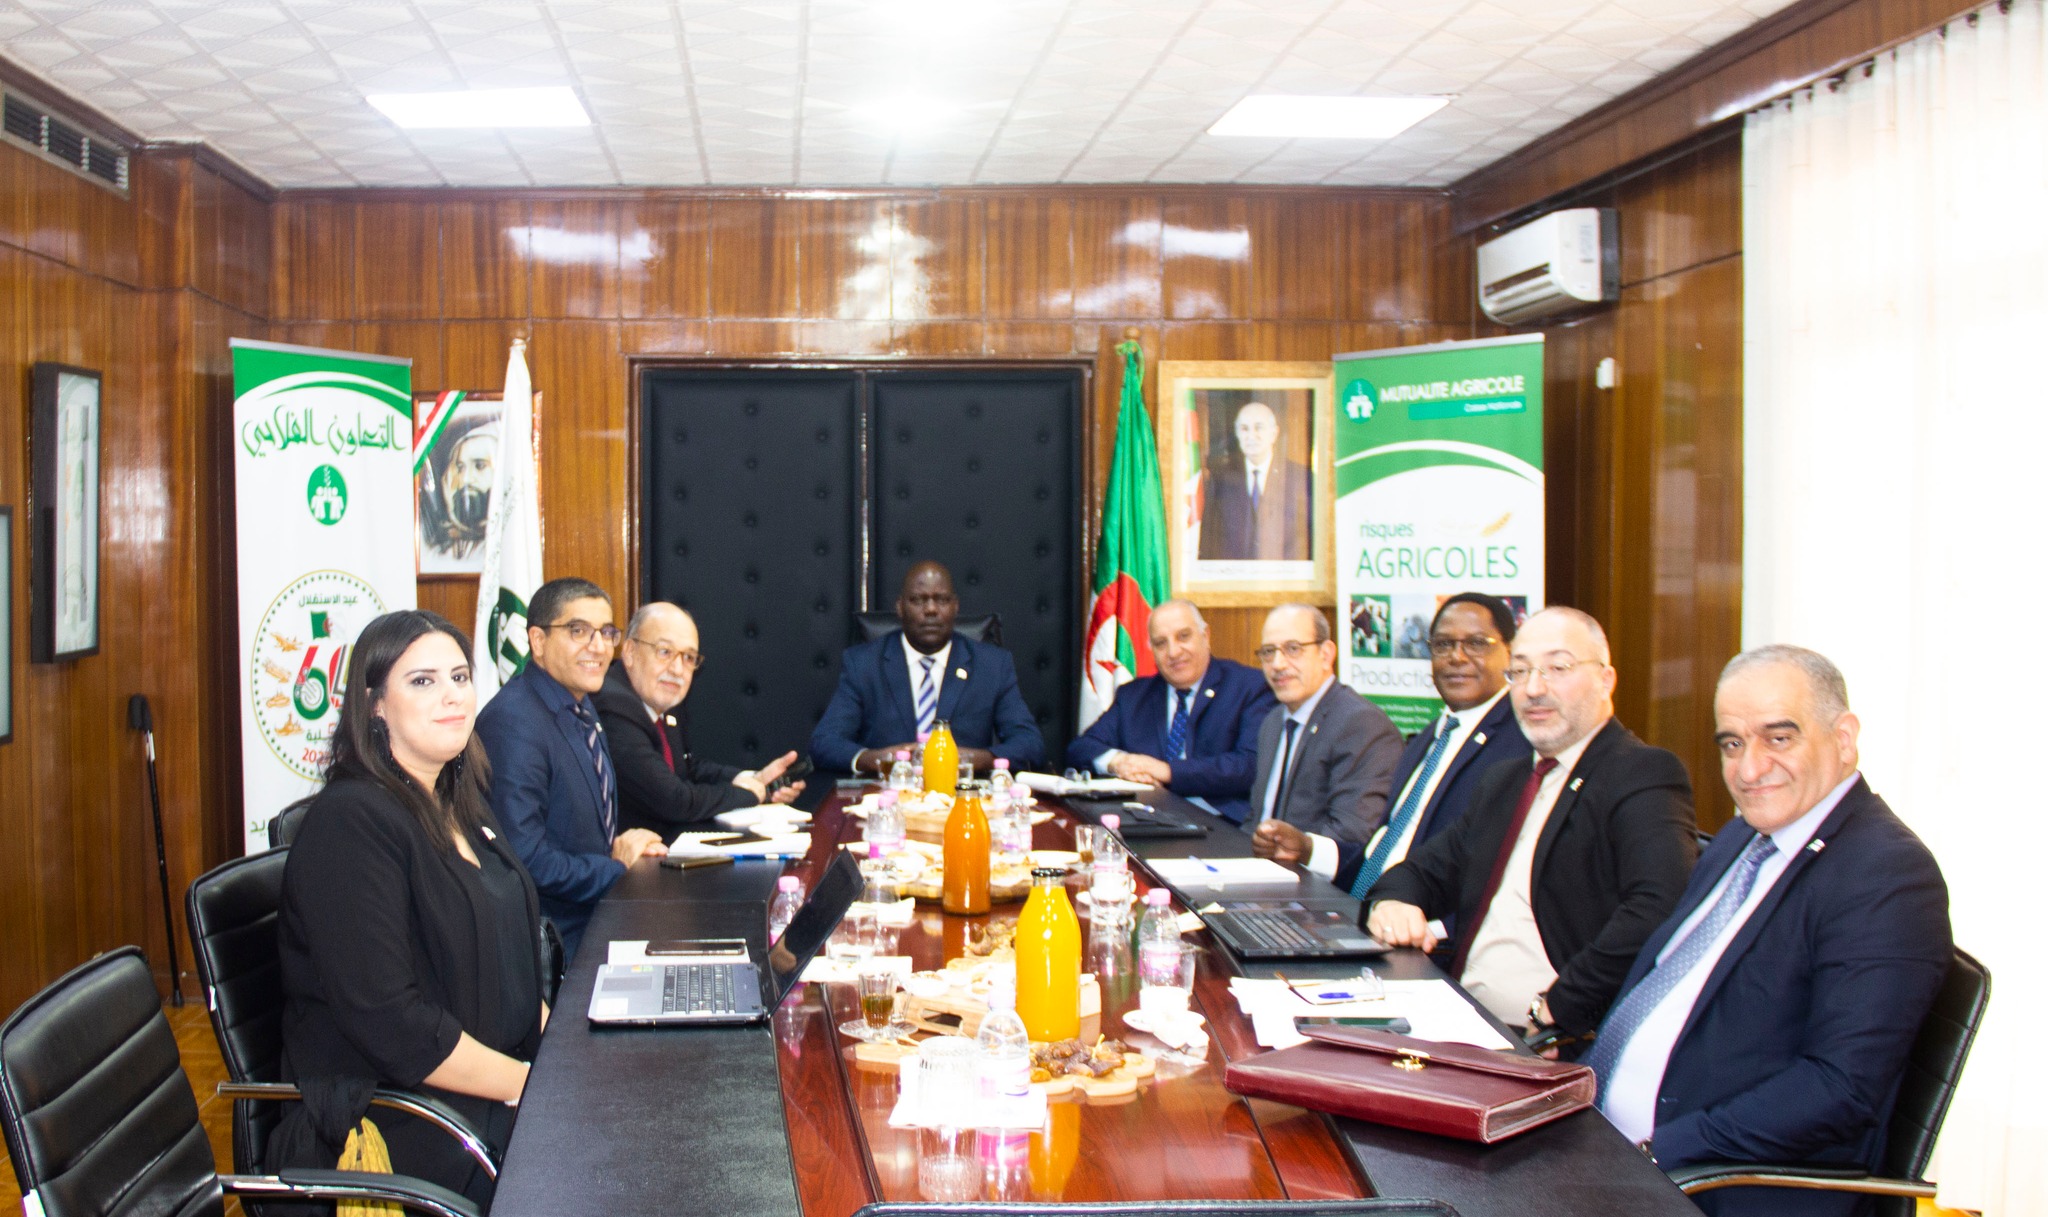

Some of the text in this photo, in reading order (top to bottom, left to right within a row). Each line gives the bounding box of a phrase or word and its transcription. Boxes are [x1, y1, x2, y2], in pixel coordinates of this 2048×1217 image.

[1380, 375, 1525, 403] MUTUALITE AGRICOLE
[242, 404, 407, 458] التعاون الفلاحي
[1359, 520, 1415, 541] risques
[1355, 546, 1519, 578] AGRICOLES
[342, 595, 358, 606] عيد
[1351, 663, 1434, 689] Productio
